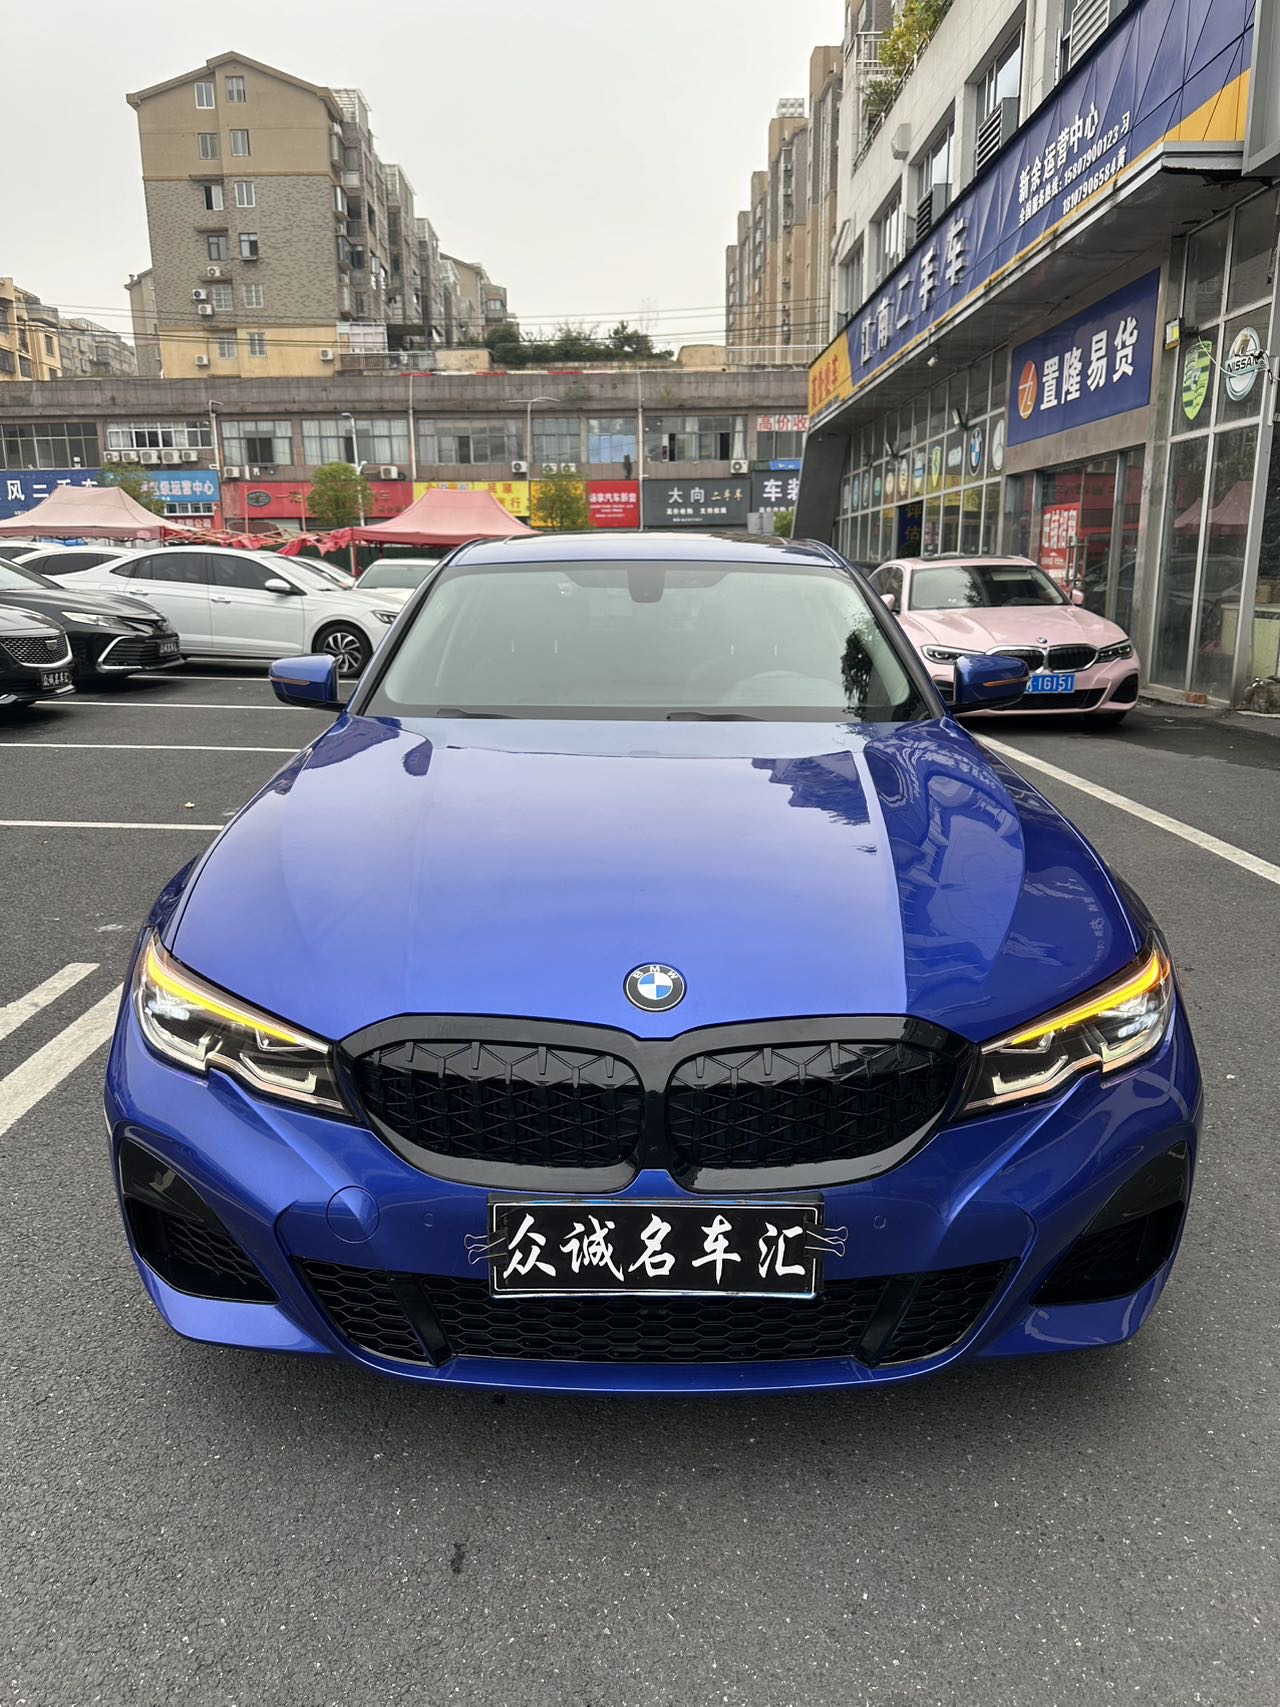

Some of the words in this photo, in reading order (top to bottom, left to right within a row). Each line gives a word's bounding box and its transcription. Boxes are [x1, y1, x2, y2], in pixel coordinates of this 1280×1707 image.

[1019, 102, 1098, 204] 新余运营中心
[861, 217, 968, 366] 江南二手车
[1040, 316, 1138, 410] 置隆易货
[759, 415, 808, 430] 高价收
[668, 487, 705, 503] 大向
[711, 488, 743, 502] 二手车
[632, 965, 678, 979] BMW
[503, 1213, 808, 1285] 众诚名车汇
